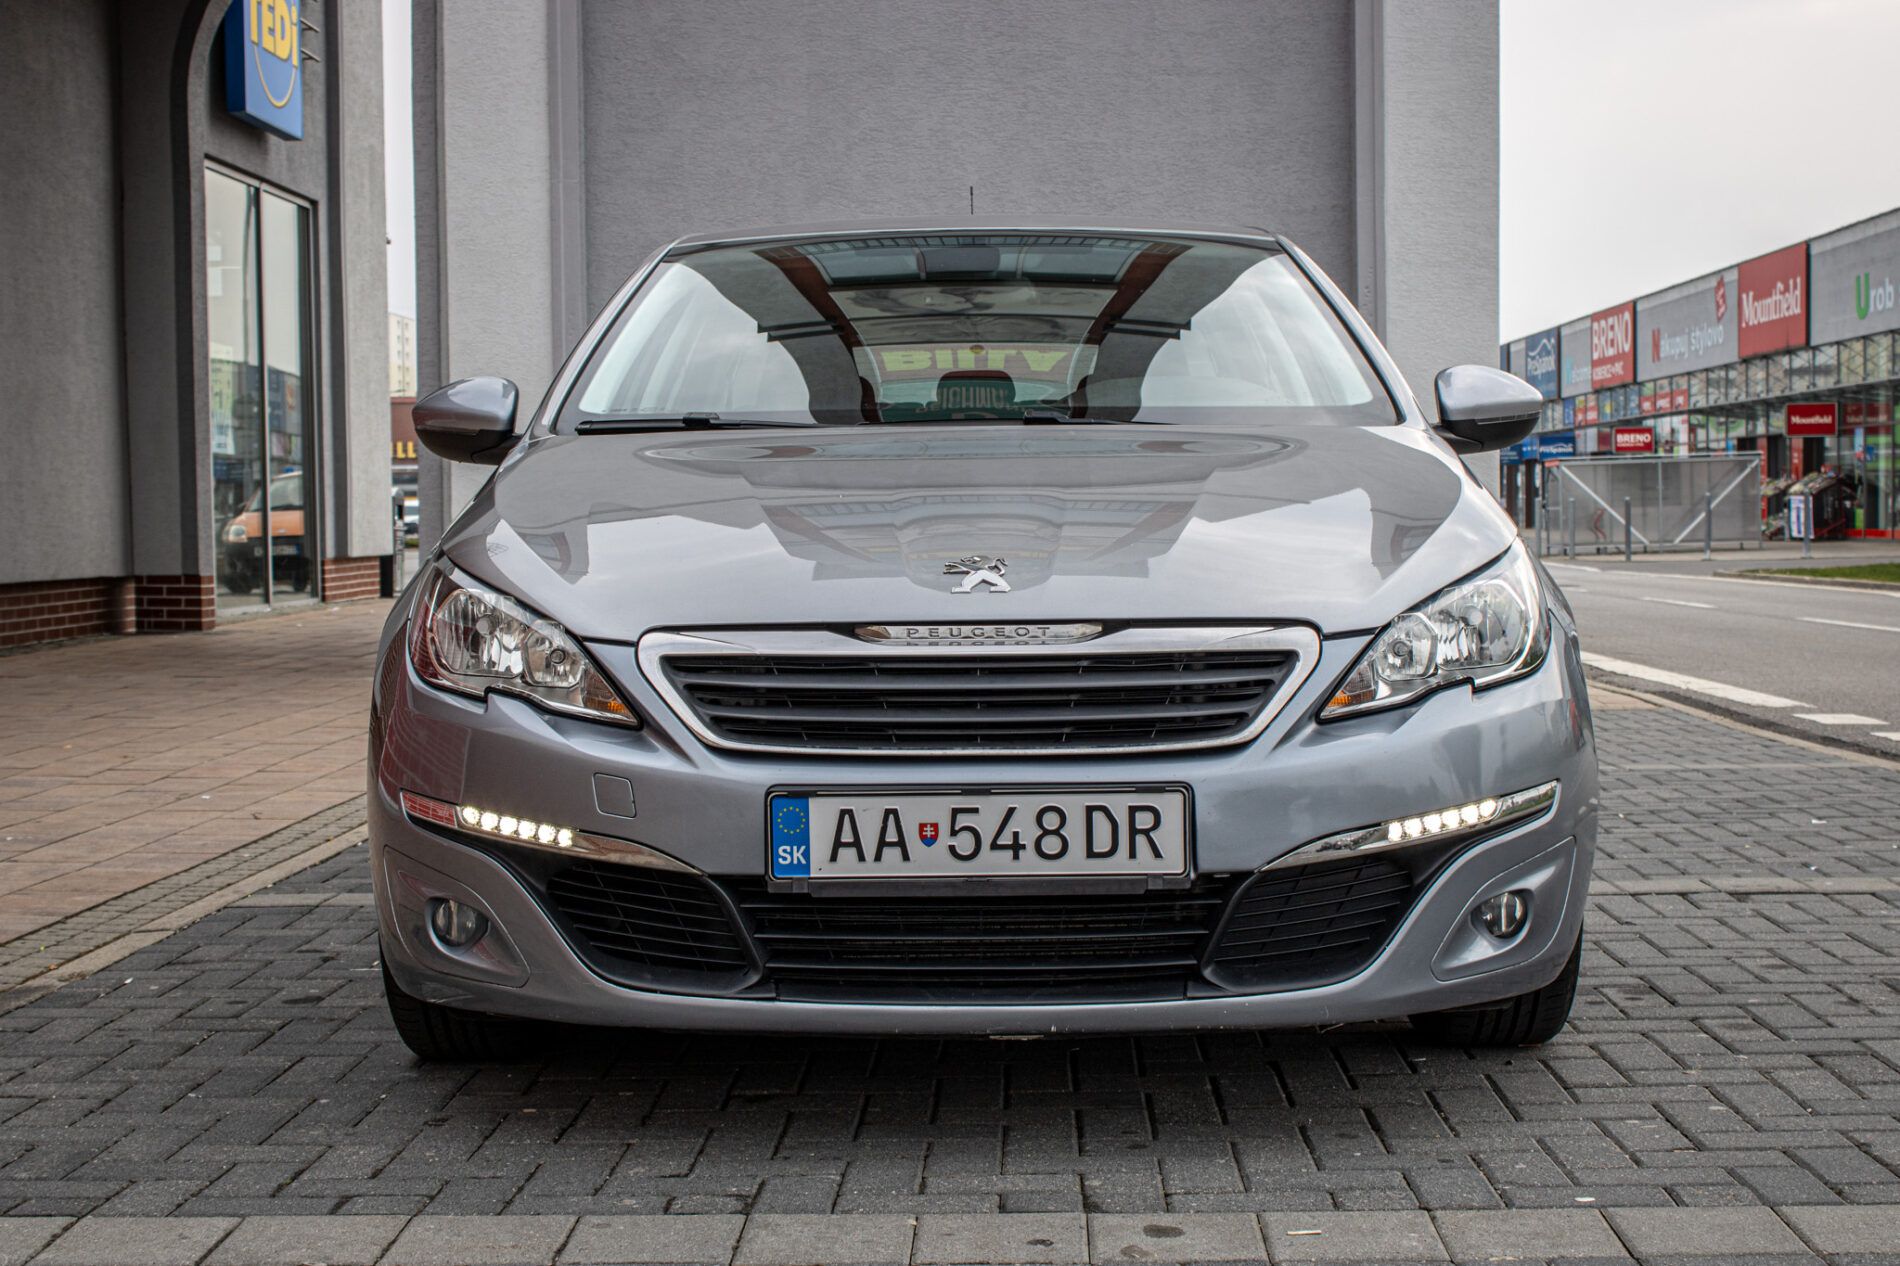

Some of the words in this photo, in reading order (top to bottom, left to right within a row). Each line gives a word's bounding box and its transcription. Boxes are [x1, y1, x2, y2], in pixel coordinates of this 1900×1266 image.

[250, 0, 298, 67] TEDi
[1741, 276, 1801, 328] Mountfield
[1856, 271, 1894, 320] Urob
[1592, 311, 1631, 360] BRENO
[1616, 433, 1651, 443] BRENO
[1790, 414, 1832, 424] Mountfield
[905, 626, 1050, 638] PEUGEOT
[778, 845, 807, 865] SK
[829, 806, 911, 863] AA
